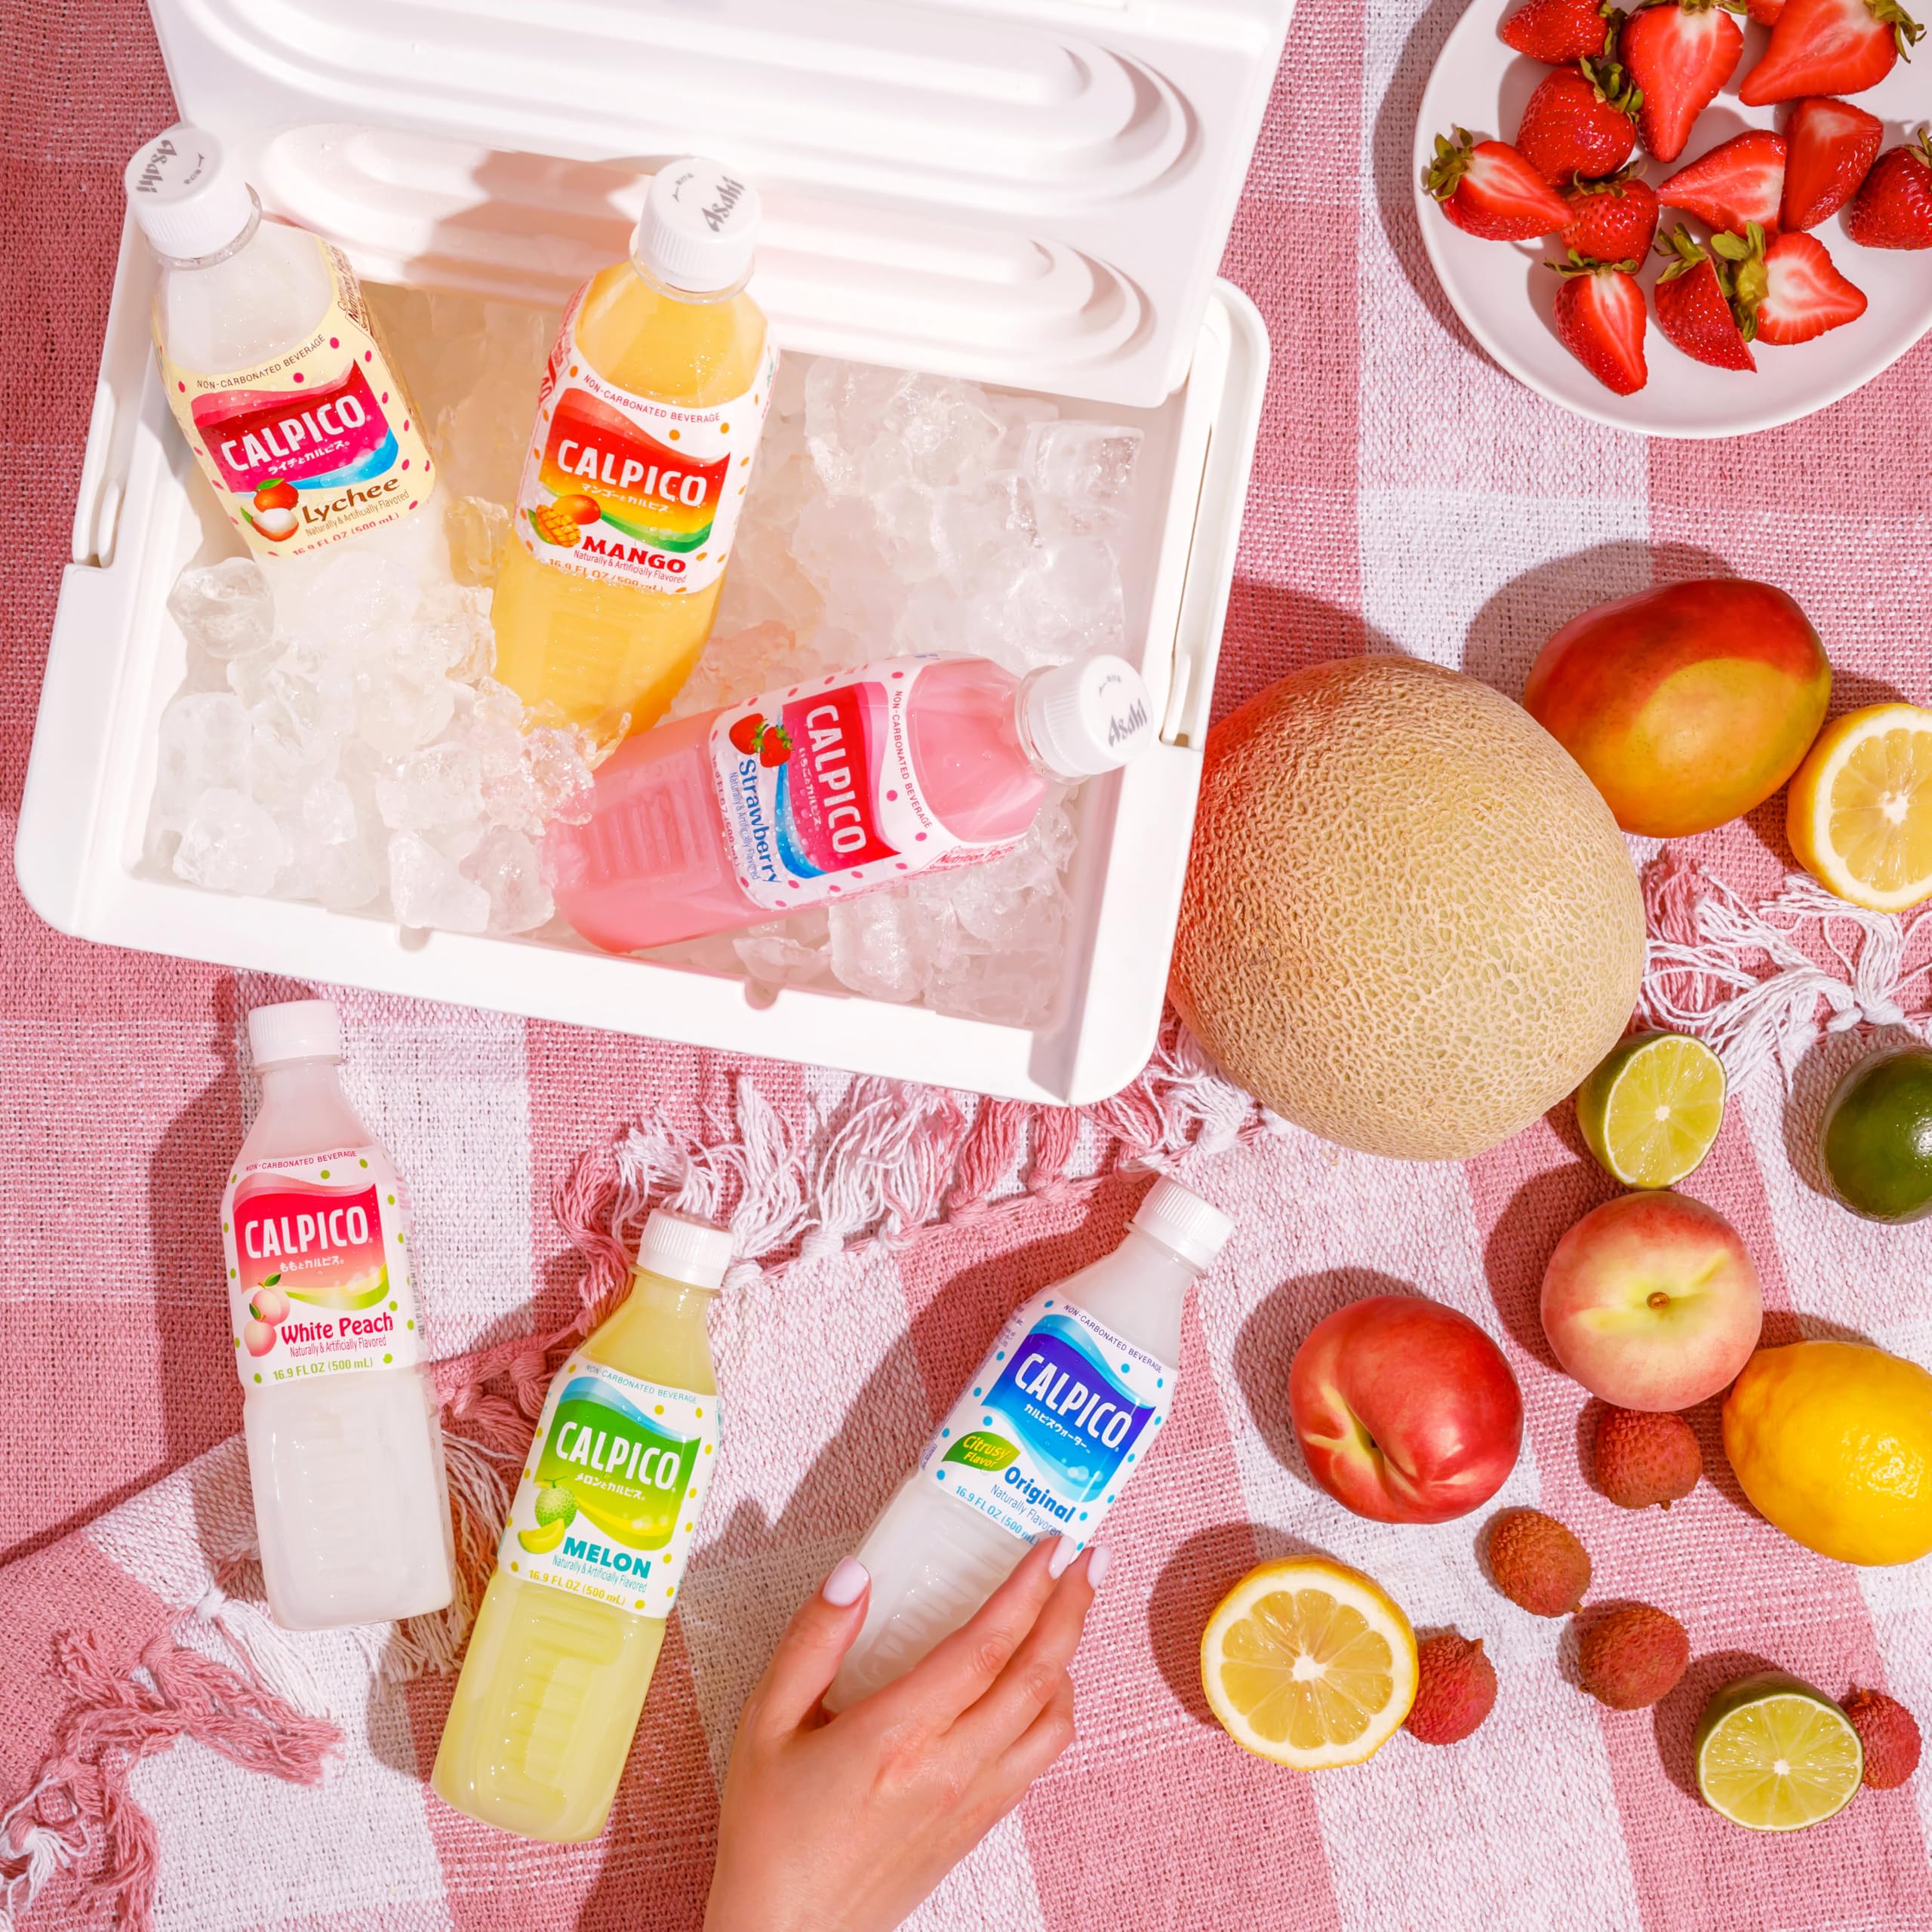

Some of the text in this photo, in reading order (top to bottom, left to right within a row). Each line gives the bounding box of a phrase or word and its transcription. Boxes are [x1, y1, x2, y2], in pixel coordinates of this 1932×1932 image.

[135, 139, 178, 193] Asahi
[701, 174, 746, 232] Asahi
[196, 334, 326, 389] NON-CARBONATED BEVERAGE
[583, 374, 721, 423] NON-CARBONATED BEVERAGE
[220, 395, 366, 472] CALPICO
[557, 438, 708, 507] CALPICO
[301, 478, 401, 525] Lychee
[305, 488, 410, 537] Naturally & Artificially Flavored
[292, 543, 315, 556] 169
[351, 521, 377, 535] (500
[378, 512, 399, 526] mL)
[581, 535, 686, 574] MANGO
[549, 558, 572, 571] 169
[574, 549, 688, 584] Naturally & Artificially Flavored
[1108, 697, 1148, 748] Asahi
[712, 755, 721, 779] 19
[806, 704, 867, 854] CALPICO
[892, 691, 933, 829] NON-CARBONATED BEVERAGE
[729, 771, 743, 808] Naturally
[746, 848, 762, 881] Flavored
[739, 758, 783, 883] Strawberry
[245, 1150, 357, 1171] NON-CARBONATED BEVERAGE
[245, 1205, 369, 1260] CALPICO
[281, 1312, 393, 1346] White Peach
[290, 1334, 387, 1358] Naturally & Artificially Flavored
[1063, 1303, 1128, 1352] NON-CARBONATED
[1128, 1348, 1163, 1374] BEVERAGE
[272, 1357, 373, 1381] 16.9 FL OZ (500 mL)
[585, 1364, 697, 1404] NON-CARBONATED BEVERAGE
[1014, 1352, 1133, 1449] CALPICO
[555, 1420, 681, 1491] CALPICO
[962, 1435, 1011, 1461] Citrusy
[963, 1451, 998, 1468] Flavor
[574, 1472, 644, 1501] メロンとカルピス
[990, 1484, 1063, 1537] Naturally Flavored
[1004, 1466, 1077, 1524] Original
[955, 1485, 1041, 1546] 16.9 FL OZ (500 mL)
[552, 1554, 648, 1593] Naturally & Artificially Flavored
[562, 1536, 651, 1580] MELON
[529, 1569, 626, 1606] 16.9 FL OZ (500 mL)
